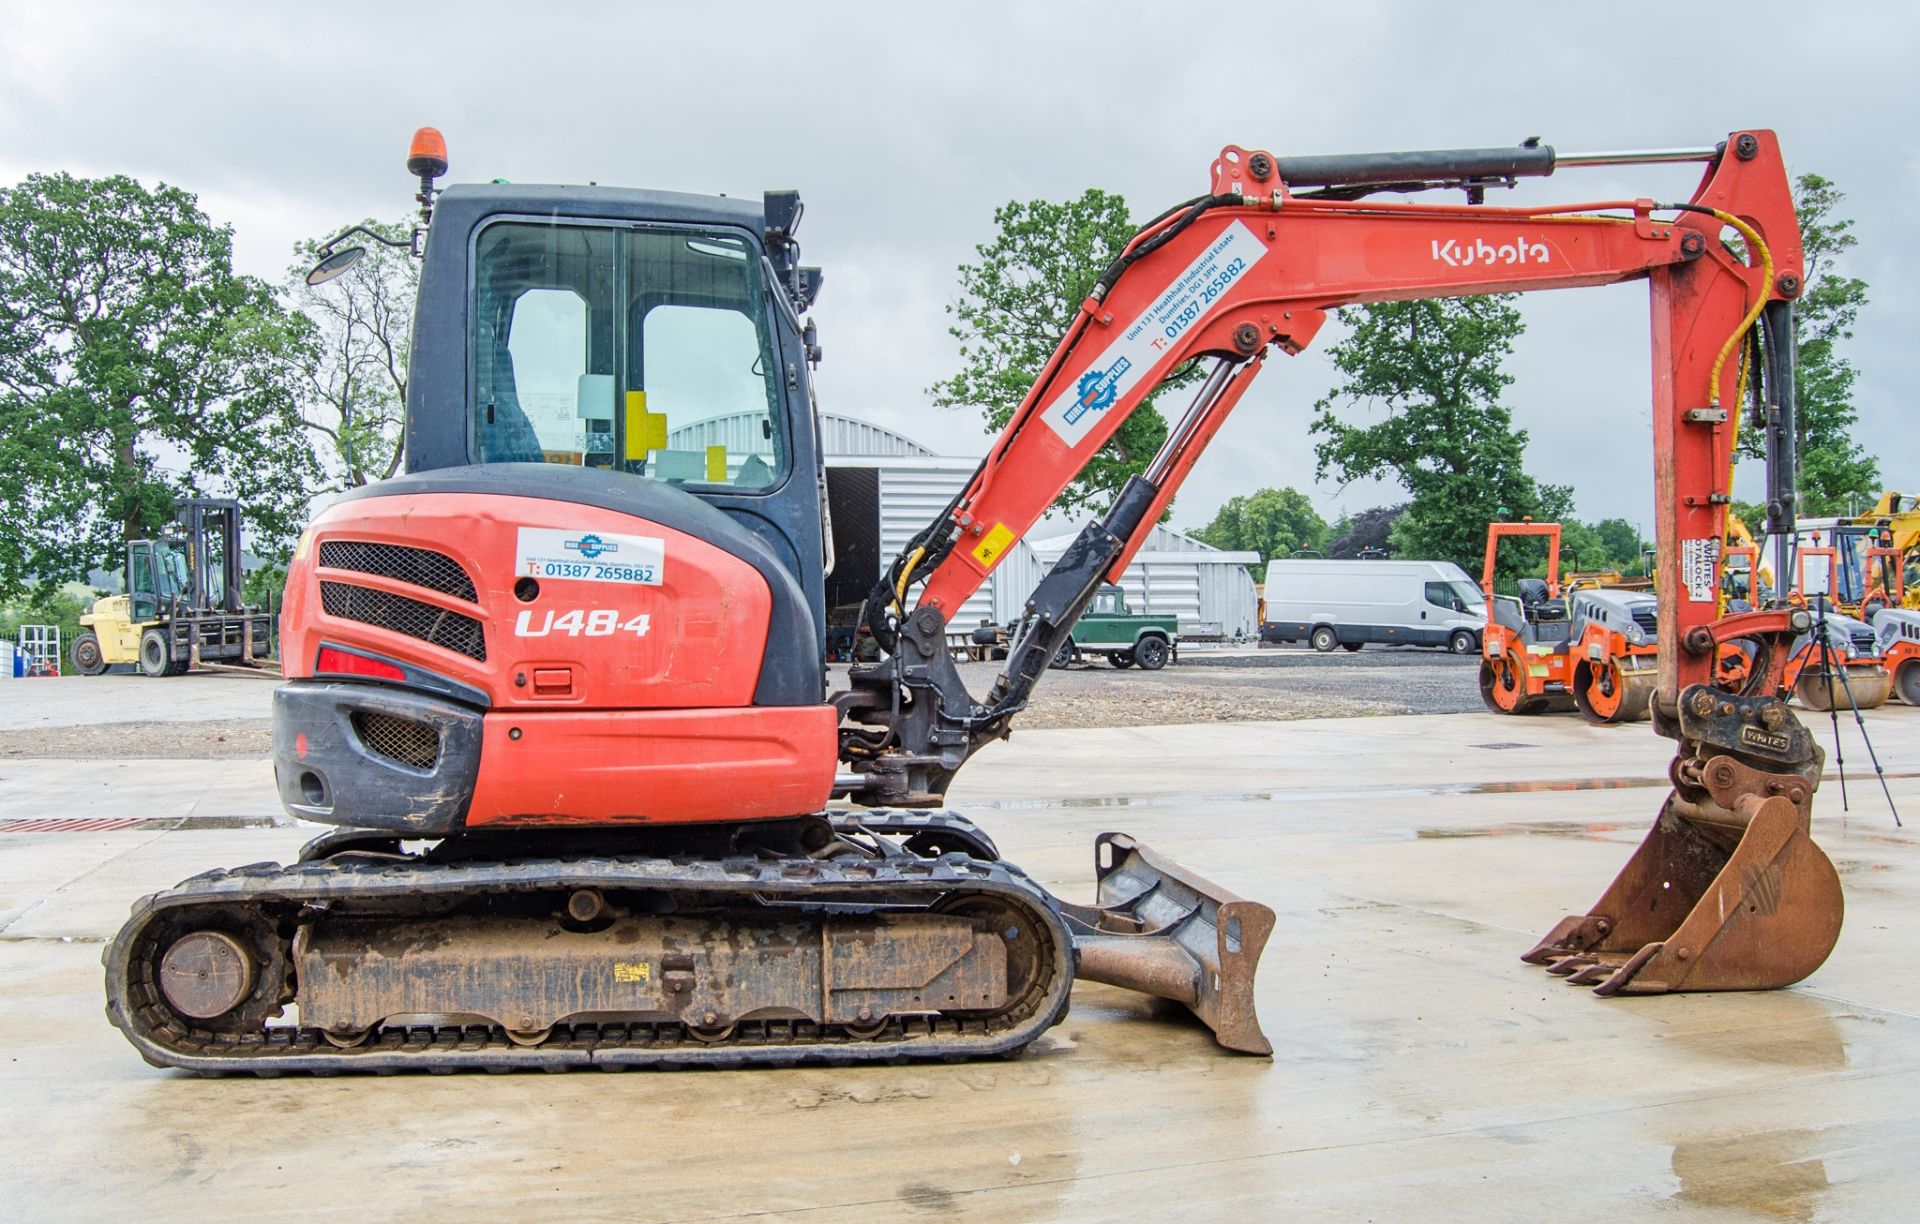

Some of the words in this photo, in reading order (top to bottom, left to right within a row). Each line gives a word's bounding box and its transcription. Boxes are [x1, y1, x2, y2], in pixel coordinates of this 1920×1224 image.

[1432, 236, 1550, 266] Kubota
[1127, 326, 1143, 341] Unit
[1142, 314, 1155, 327] 131
[1154, 282, 1186, 315] Heathhall
[1184, 253, 1215, 284] Industrial
[1213, 233, 1235, 254] Estate
[1189, 278, 1204, 294] DG1
[1204, 264, 1218, 279] 3PH
[1151, 337, 1167, 350] T:
[1165, 300, 1202, 339] 01387
[1200, 257, 1246, 305] 265882
[1066, 403, 1085, 423] HIRE
[1095, 358, 1129, 392] SUPPLIES
[528, 563, 540, 574] T:
[546, 564, 591, 577] 01387
[595, 567, 652, 581] 265882
[1704, 544, 1712, 587] WHITES
